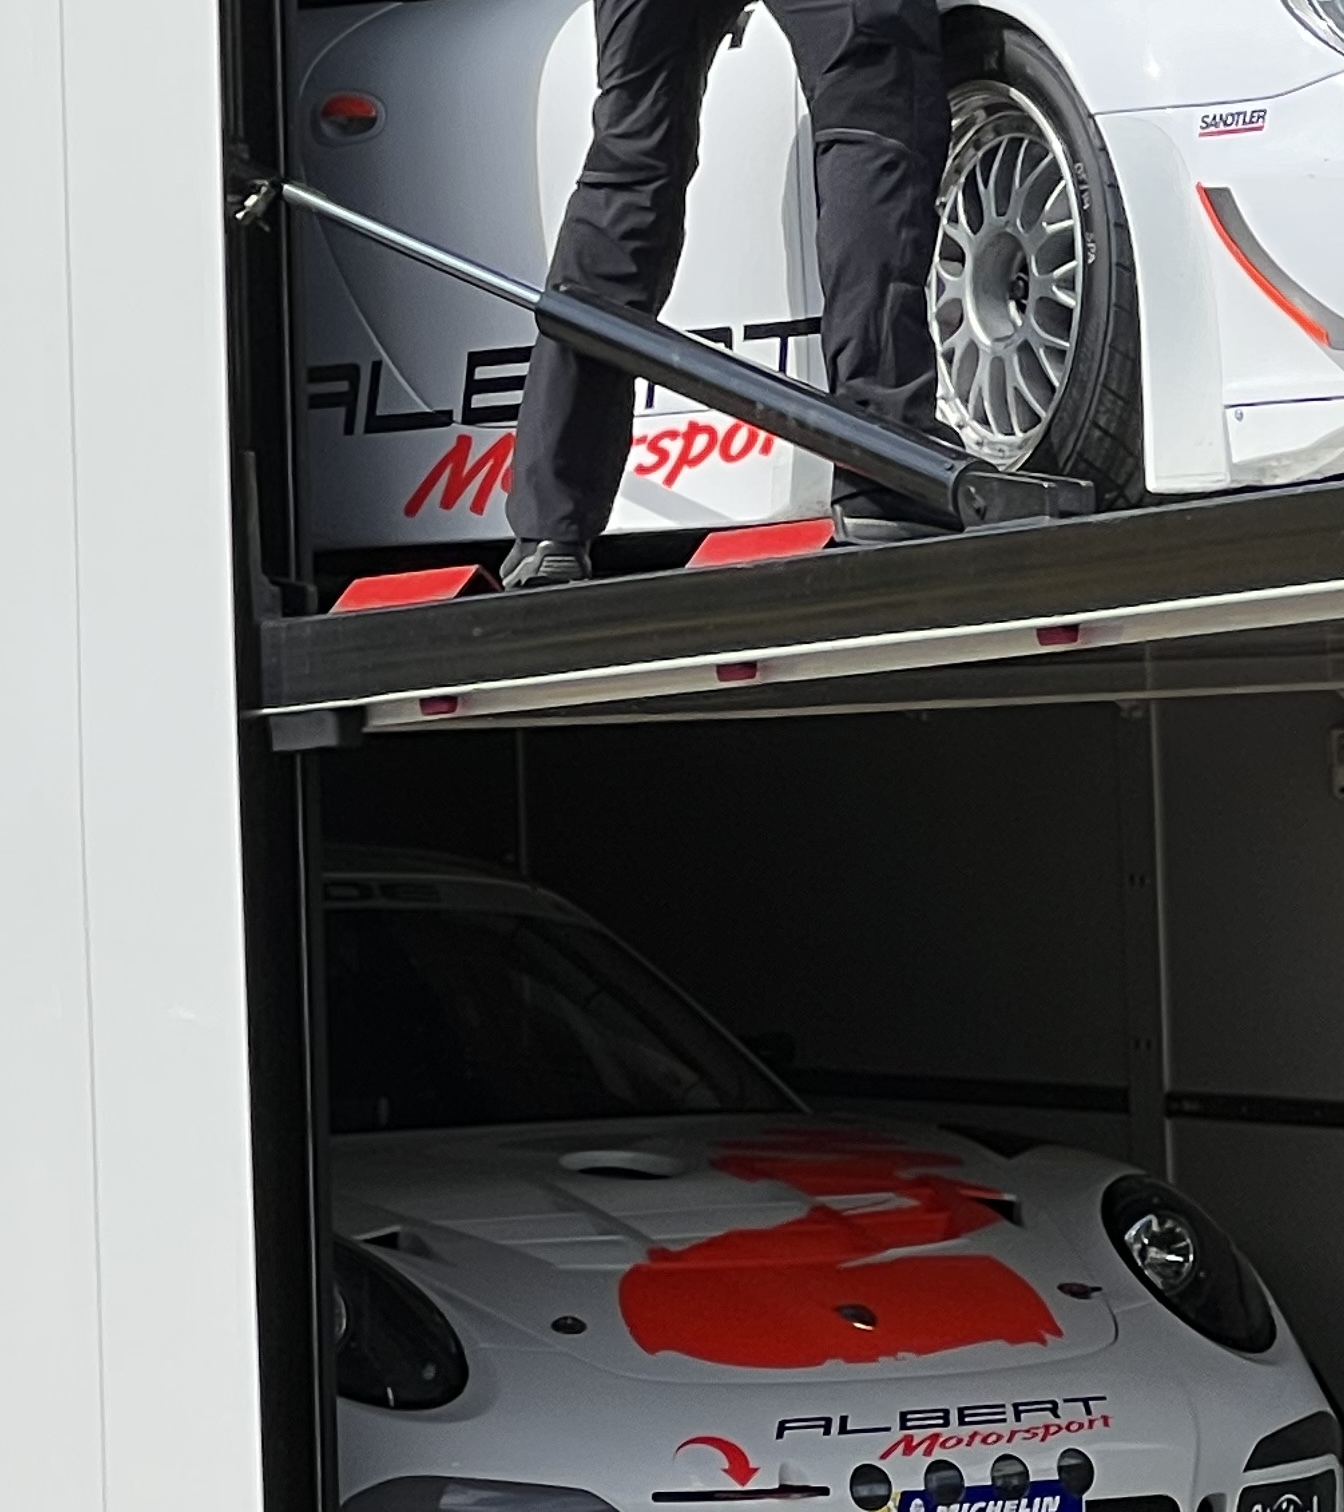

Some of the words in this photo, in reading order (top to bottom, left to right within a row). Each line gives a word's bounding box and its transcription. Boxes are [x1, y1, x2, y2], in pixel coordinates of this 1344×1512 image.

[1199, 108, 1268, 131] SANDTLER
[774, 1395, 1108, 1441] ALBERT
[878, 1414, 1115, 1460] Motorsport
